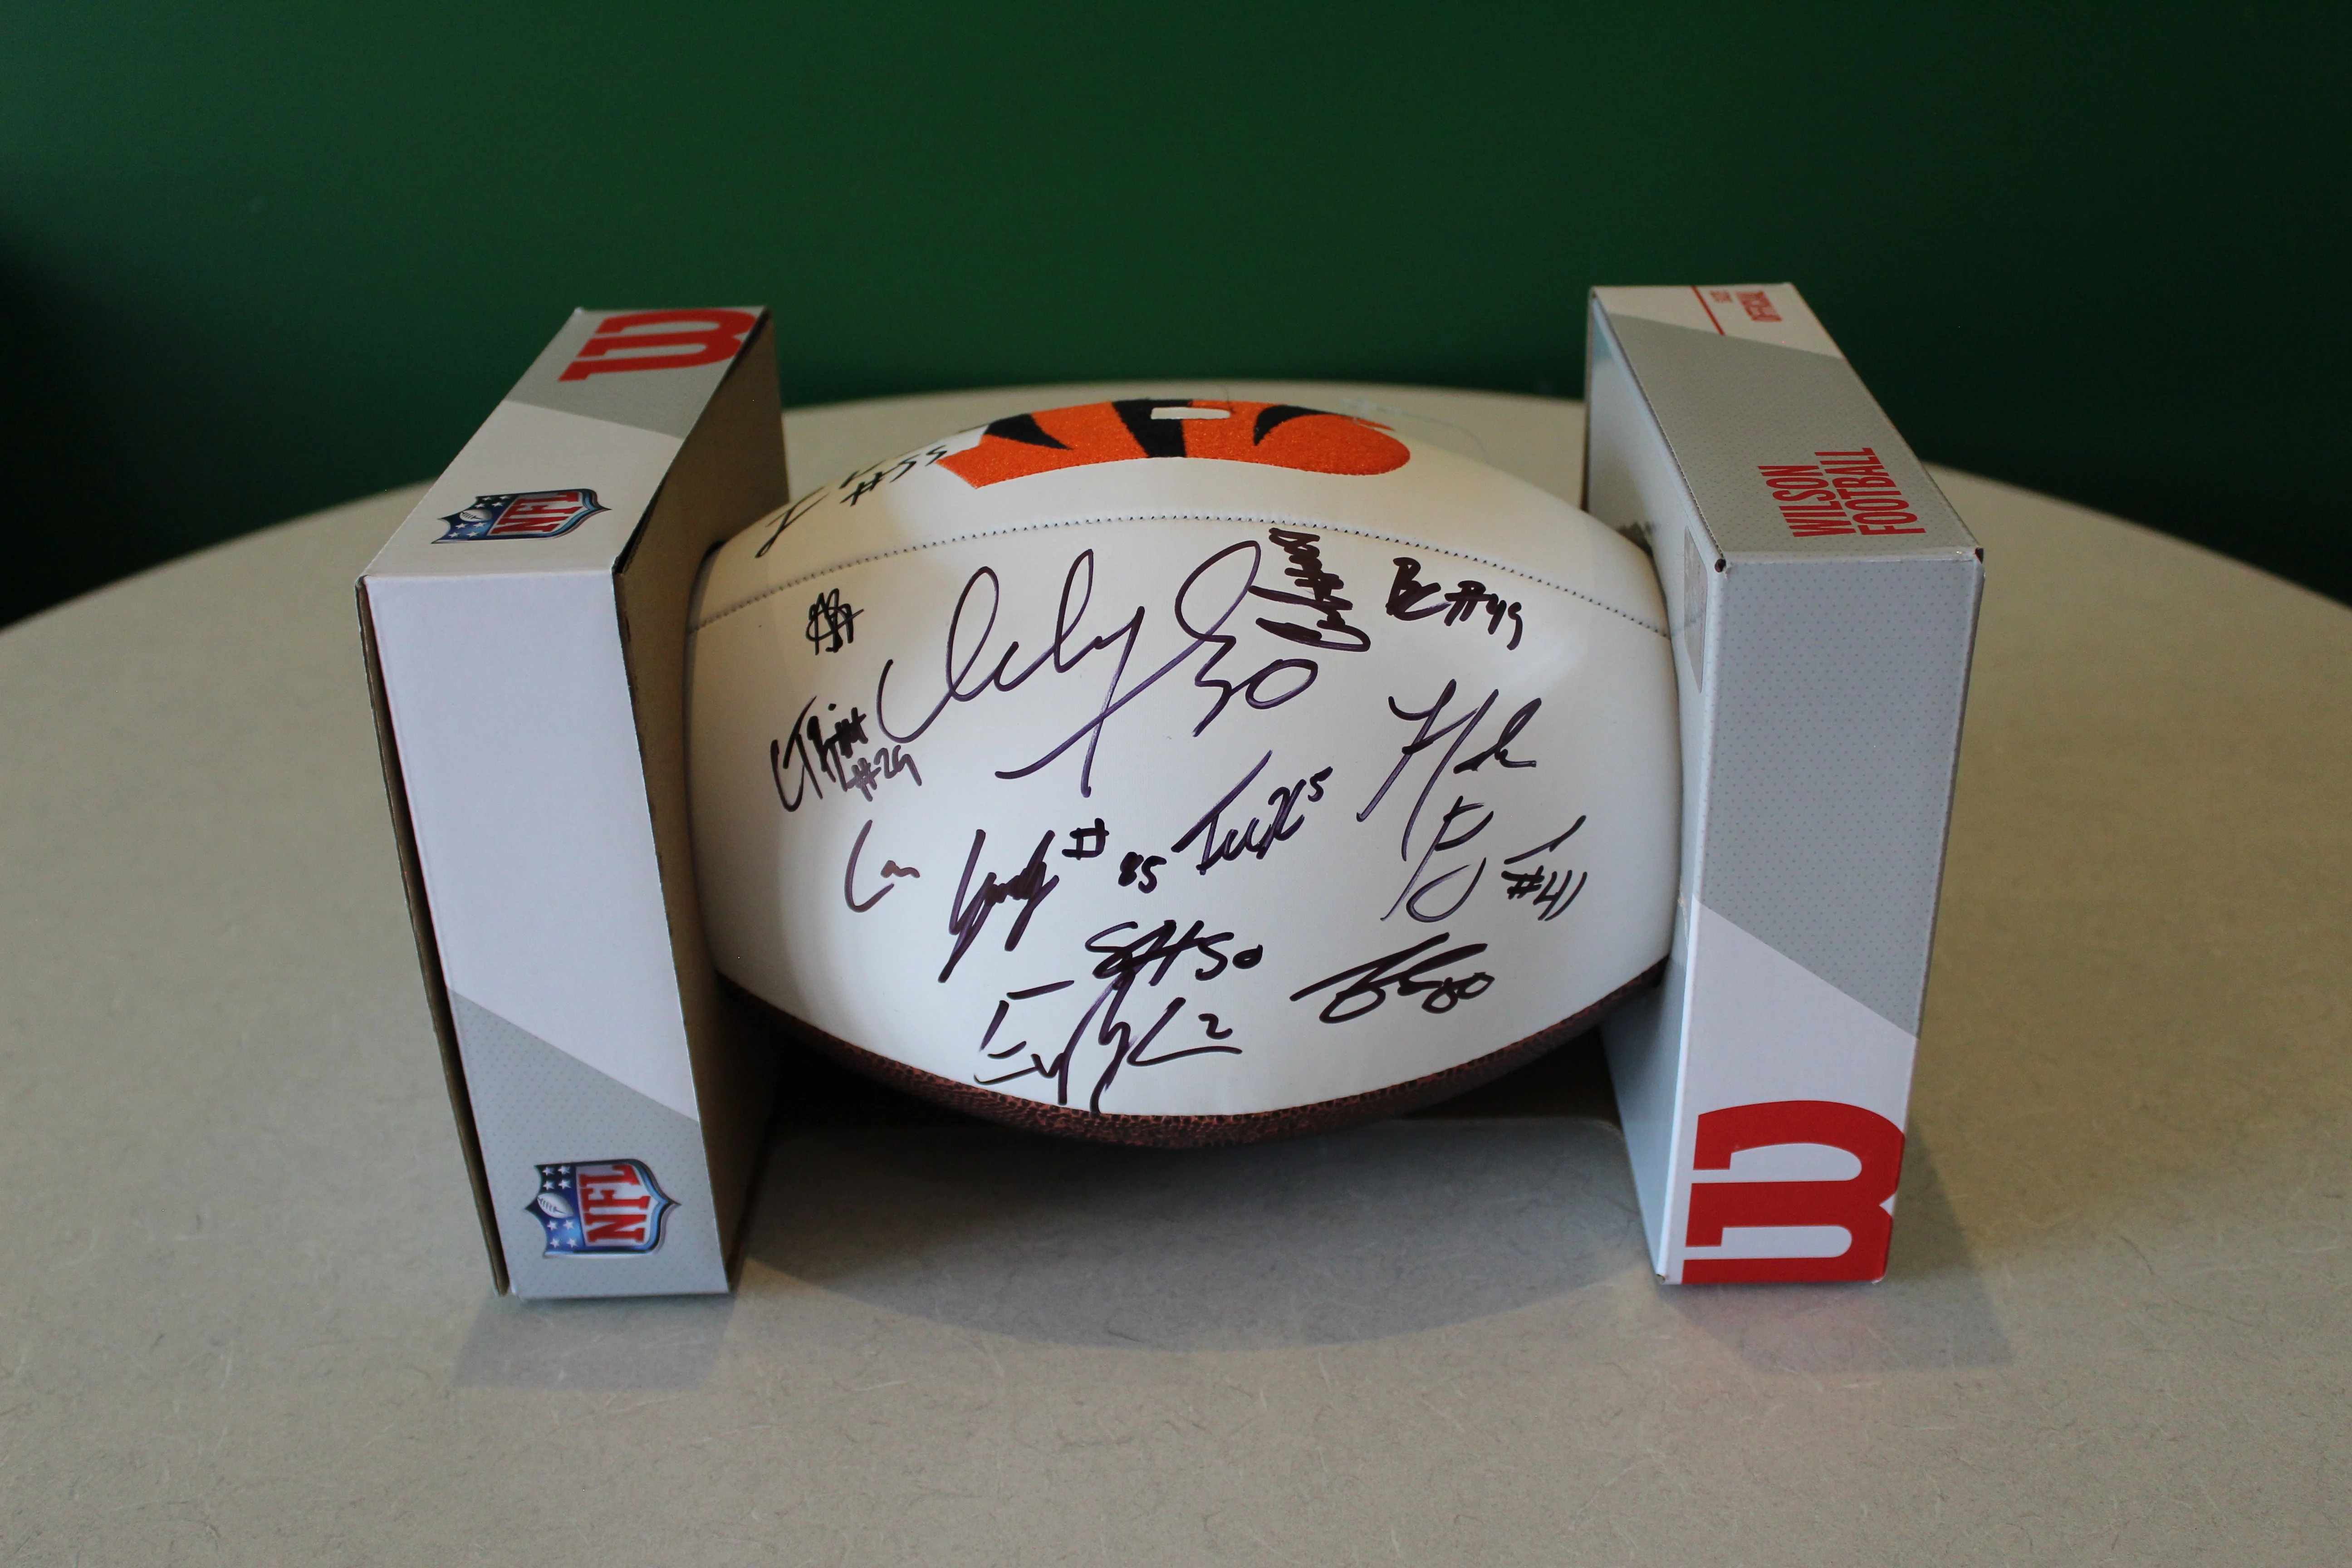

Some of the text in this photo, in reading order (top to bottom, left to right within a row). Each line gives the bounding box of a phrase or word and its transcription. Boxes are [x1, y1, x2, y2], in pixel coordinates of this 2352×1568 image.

[490, 491, 584, 534] NFL
[1758, 466, 1857, 537] WILSON
[1814, 447, 1926, 535] FOOTBALL
[579, 1164, 651, 1243] NFL
